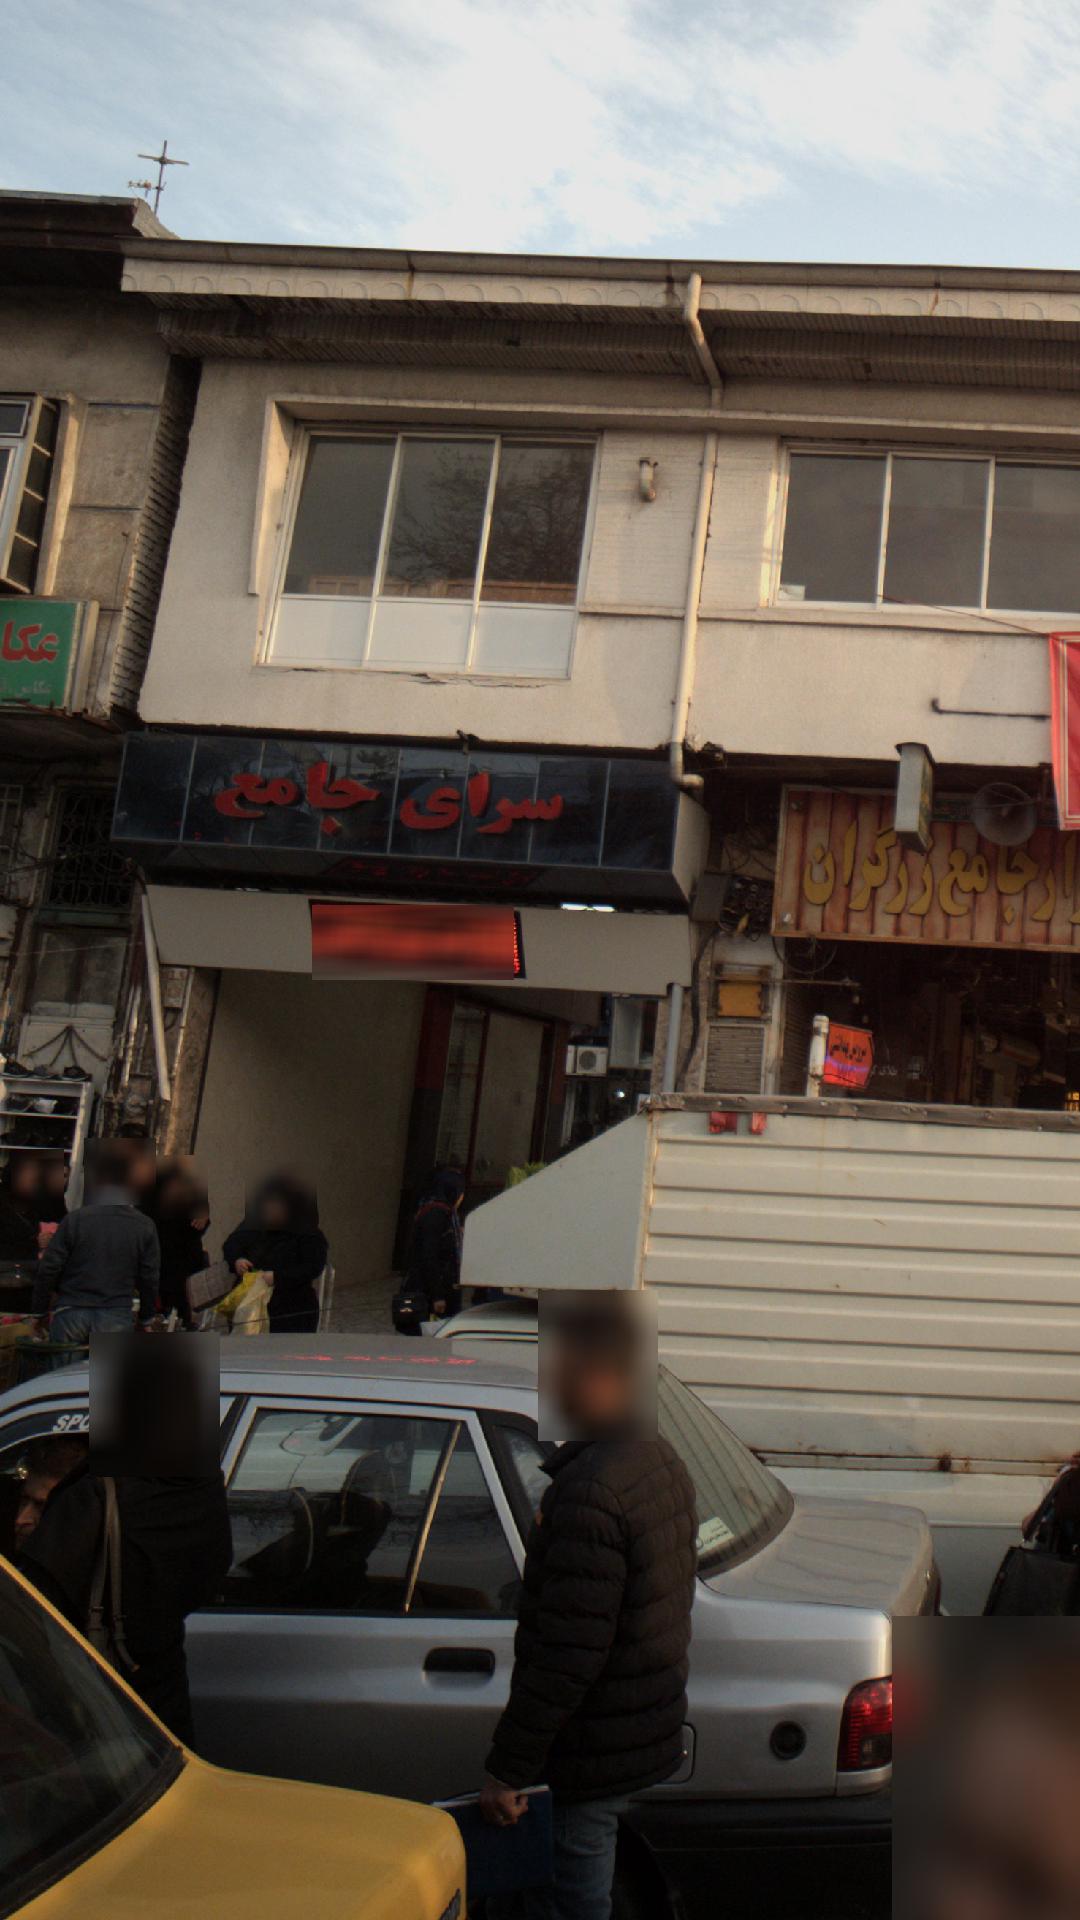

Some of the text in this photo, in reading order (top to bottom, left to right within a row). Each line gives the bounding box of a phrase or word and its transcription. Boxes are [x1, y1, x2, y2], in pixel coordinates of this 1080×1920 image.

[215, 761, 565, 838] سرای جامع
[939, 838, 1040, 925] جامع
[1031, 830, 1080, 925] ار
